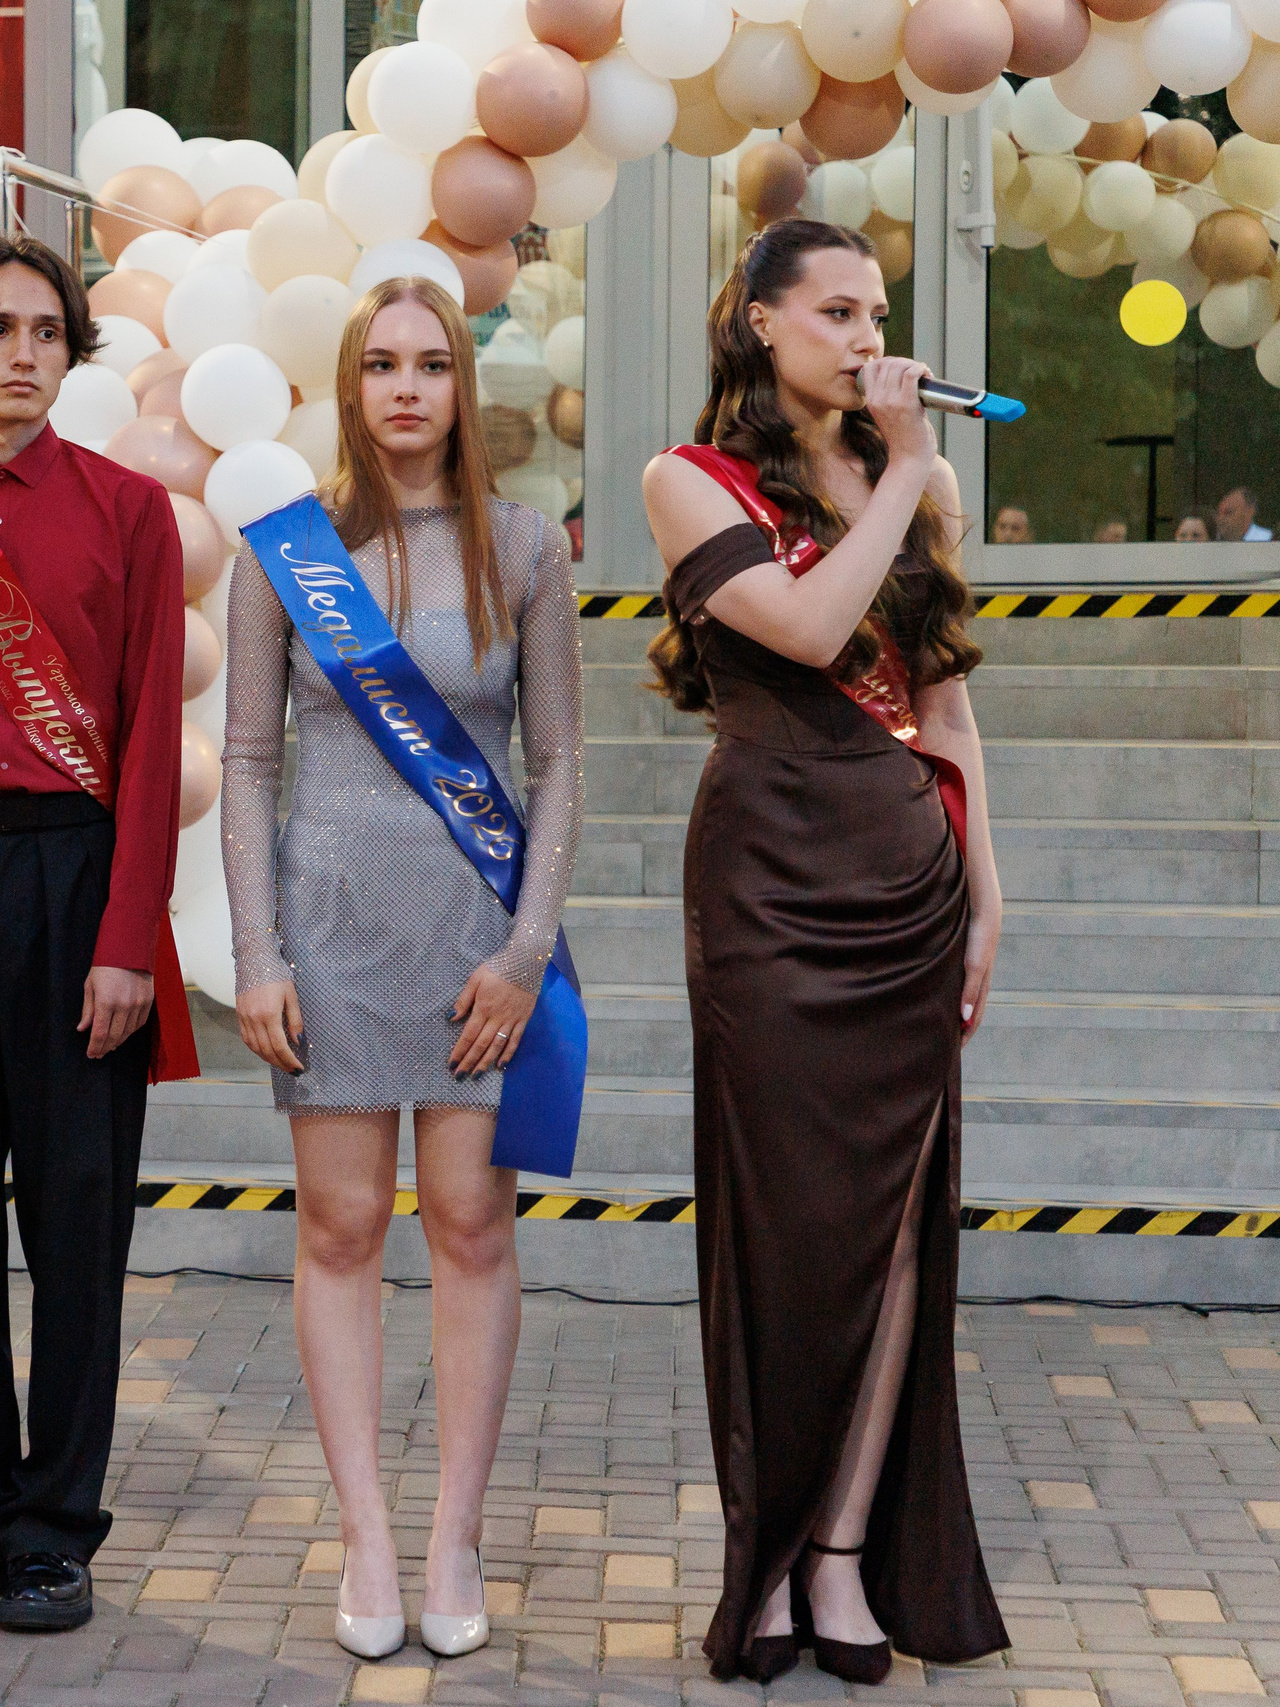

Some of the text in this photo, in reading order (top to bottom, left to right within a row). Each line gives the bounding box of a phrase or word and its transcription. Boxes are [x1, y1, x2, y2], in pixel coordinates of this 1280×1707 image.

[42, 654, 86, 716] Угрюмов
[280, 542, 524, 860] Медалист 2026
[23, 721, 47, 753] Школа
